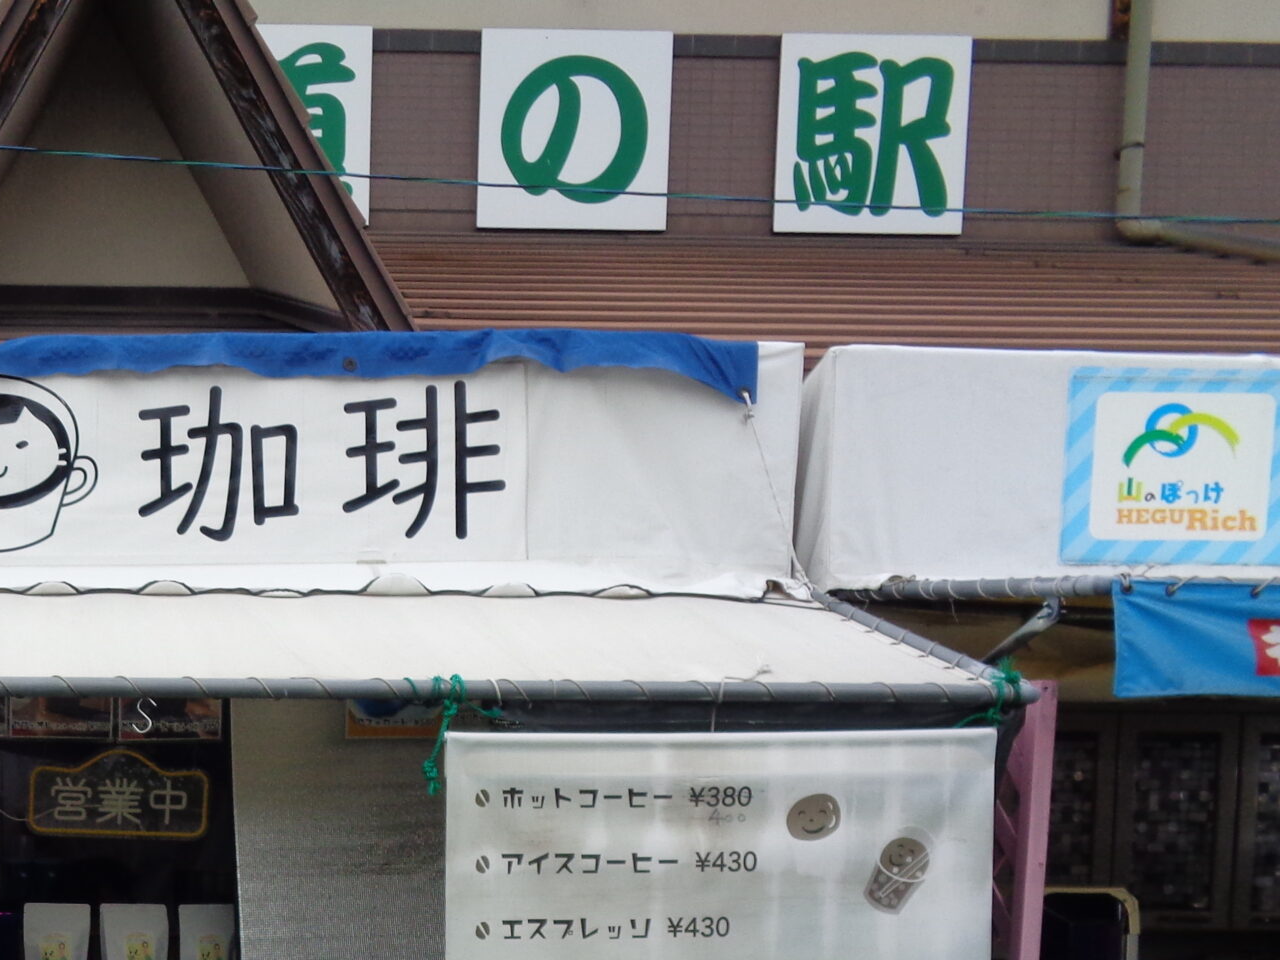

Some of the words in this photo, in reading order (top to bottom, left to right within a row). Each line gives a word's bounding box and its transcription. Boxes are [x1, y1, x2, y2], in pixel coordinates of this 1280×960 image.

[138, 381, 506, 541] 珈琲
[1117, 477, 1225, 504] 山のぽっけ
[50, 777, 187, 825] 営業中
[502, 787, 674, 809] ホットコーヒー
[688, 786, 752, 808] ¥380
[501, 852, 678, 875] アイスコーヒー
[696, 851, 757, 872] ¥430
[502, 918, 651, 939] エスプレッソ
[667, 916, 730, 938] ¥430
